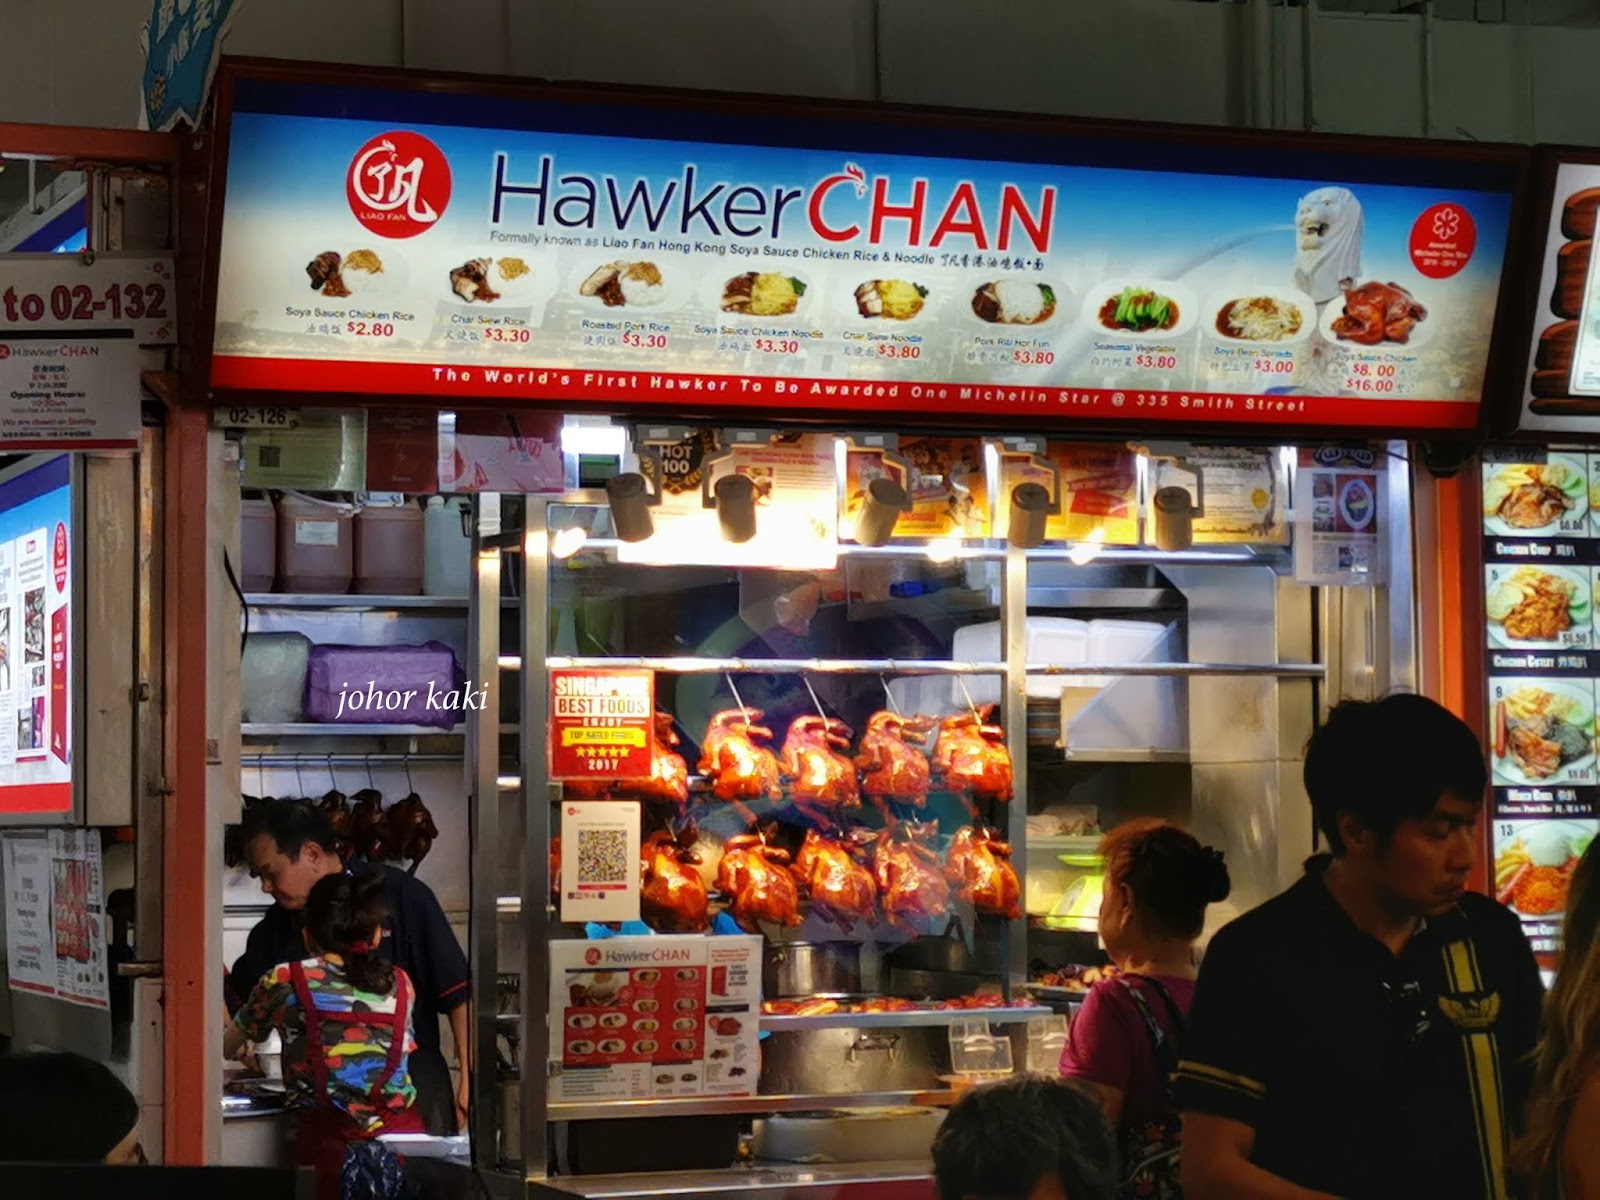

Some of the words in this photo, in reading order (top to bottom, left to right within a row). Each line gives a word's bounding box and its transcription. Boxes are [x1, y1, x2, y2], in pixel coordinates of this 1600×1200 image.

[492, 155, 1055, 253] HawkerCHAN
[360, 211, 384, 220] LIAO
[387, 213, 406, 221] FAN
[490, 230, 540, 246] Formally
[543, 233, 581, 246] known
[584, 237, 598, 247] as
[602, 236, 628, 248] Liao
[632, 239, 655, 249] Fan
[658, 239, 690, 254] Hong
[694, 241, 726, 256] Kong
[730, 244, 759, 257] Soya
[763, 245, 799, 257] Sauce
[802, 247, 850, 260] Chicken
[853, 250, 878, 261] Rice
[882, 252, 890, 262] &
[894, 252, 935, 264] Noodle
[3, 286, 45, 322] to
[51, 283, 168, 321] 02-132
[286, 306, 311, 318] Soya
[314, 307, 346, 318] Sauce
[349, 309, 390, 320] Chicken
[393, 311, 415, 322] Rice
[451, 314, 475, 324] Char
[504, 316, 526, 326] Rice
[347, 321, 394, 337] $2.80
[581, 319, 622, 331] Roasted
[624, 321, 646, 333] Pork
[649, 323, 671, 333] Rice
[694, 324, 718, 336] Soya
[751, 327, 790, 338] Chicken
[485, 327, 530, 342] $3.30
[622, 333, 667, 348] $3.30
[755, 339, 799, 353] $3.30
[878, 344, 921, 359] $3.80
[1014, 351, 1055, 365] $3.80
[1136, 355, 1176, 369] $3.80
[1254, 359, 1294, 374] $3.00
[432, 368, 471, 382] The
[484, 370, 570, 386] World's
[583, 374, 638, 389] First
[650, 376, 729, 391] Hawker
[741, 380, 762, 392] To
[775, 381, 799, 394] Be
[810, 382, 899, 398] Awarded
[911, 385, 948, 399] One
[960, 387, 1047, 403] Michelin
[1059, 390, 1100, 405] Star
[1112, 391, 1126, 407] @
[1136, 394, 1169, 407] 335
[1180, 395, 1234, 409] Smith
[1245, 398, 1305, 412] Street
[1346, 378, 1394, 392] $16.00
[228, 408, 287, 425] 02-126
[660, 444, 693, 460] HOT
[662, 459, 691, 474] 100
[559, 698, 594, 714] BEST
[600, 698, 645, 714] FOODS
[582, 717, 623, 727] ENJOY
[569, 730, 584, 740] TOP
[588, 758, 619, 771] 2017
[1501, 824, 1514, 837] 13
[606, 948, 690, 962] HawkerCHAN
